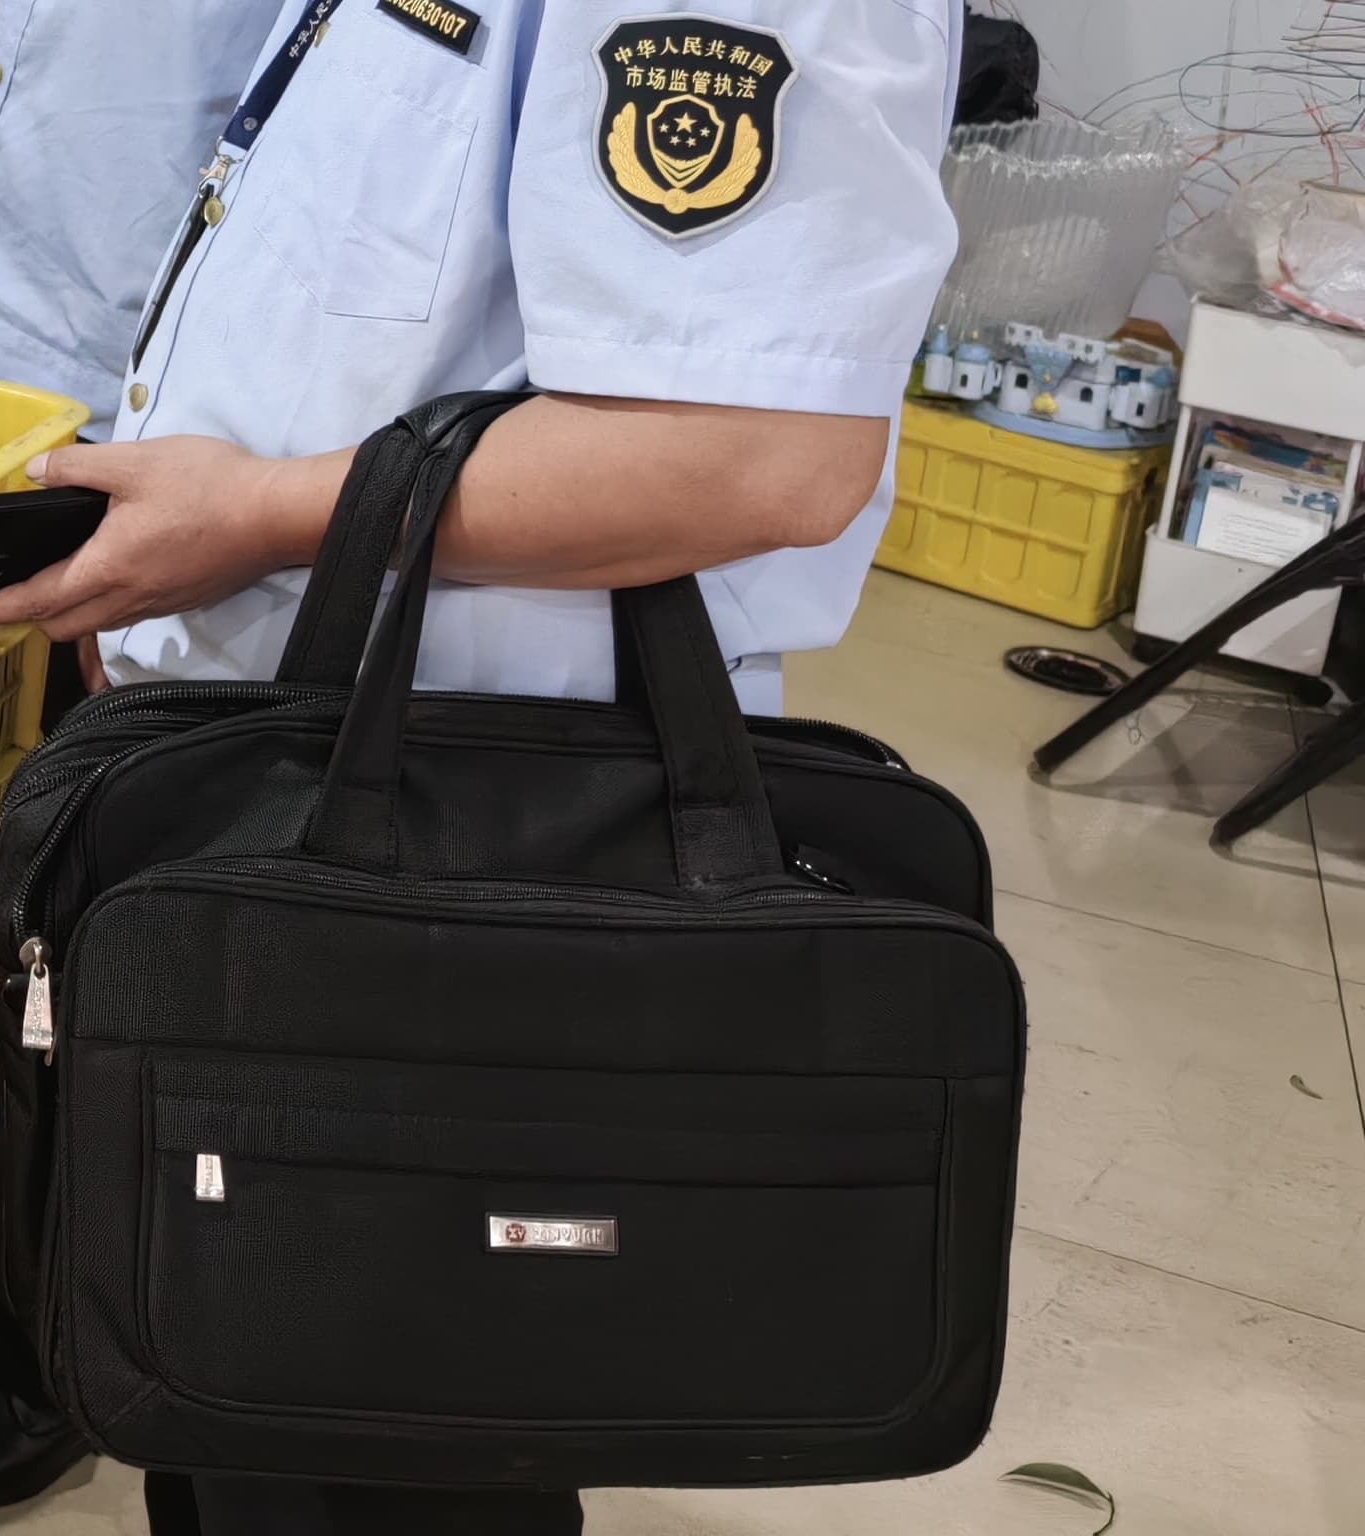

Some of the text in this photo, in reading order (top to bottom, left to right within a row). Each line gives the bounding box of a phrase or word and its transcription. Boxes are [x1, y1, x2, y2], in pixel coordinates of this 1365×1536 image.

[614, 36, 773, 77] 中华人民共和国
[625, 65, 758, 100] 市场监管执法
